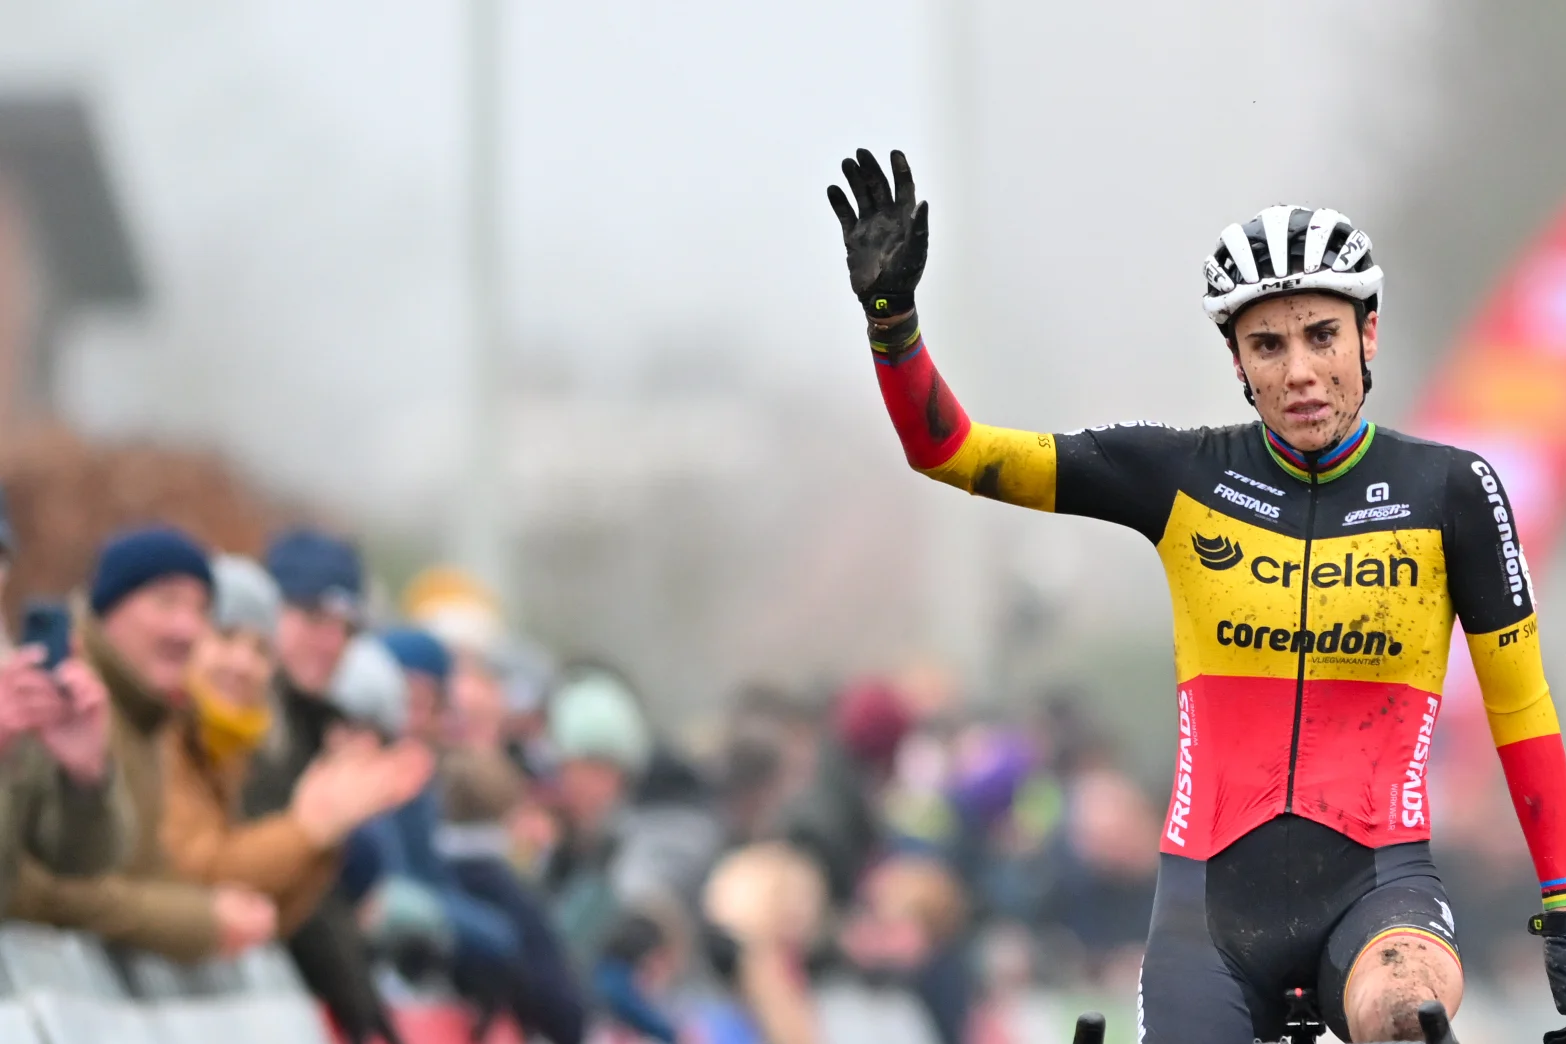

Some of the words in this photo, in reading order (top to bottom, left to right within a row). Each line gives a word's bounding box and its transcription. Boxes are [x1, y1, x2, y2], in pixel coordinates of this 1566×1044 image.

[1224, 469, 1287, 496] STEVENS
[1213, 483, 1281, 519] FRISTADS
[1251, 552, 1418, 588] crelan
[1499, 629, 1520, 648] DT
[1311, 655, 1381, 666] VLIEGVAKANTIES
[1189, 689, 1199, 746] WORKWEAR
[1167, 689, 1193, 847] FRISTADS
[1402, 696, 1438, 828] FRISTADS
[1388, 783, 1399, 832] WORKWEAR
